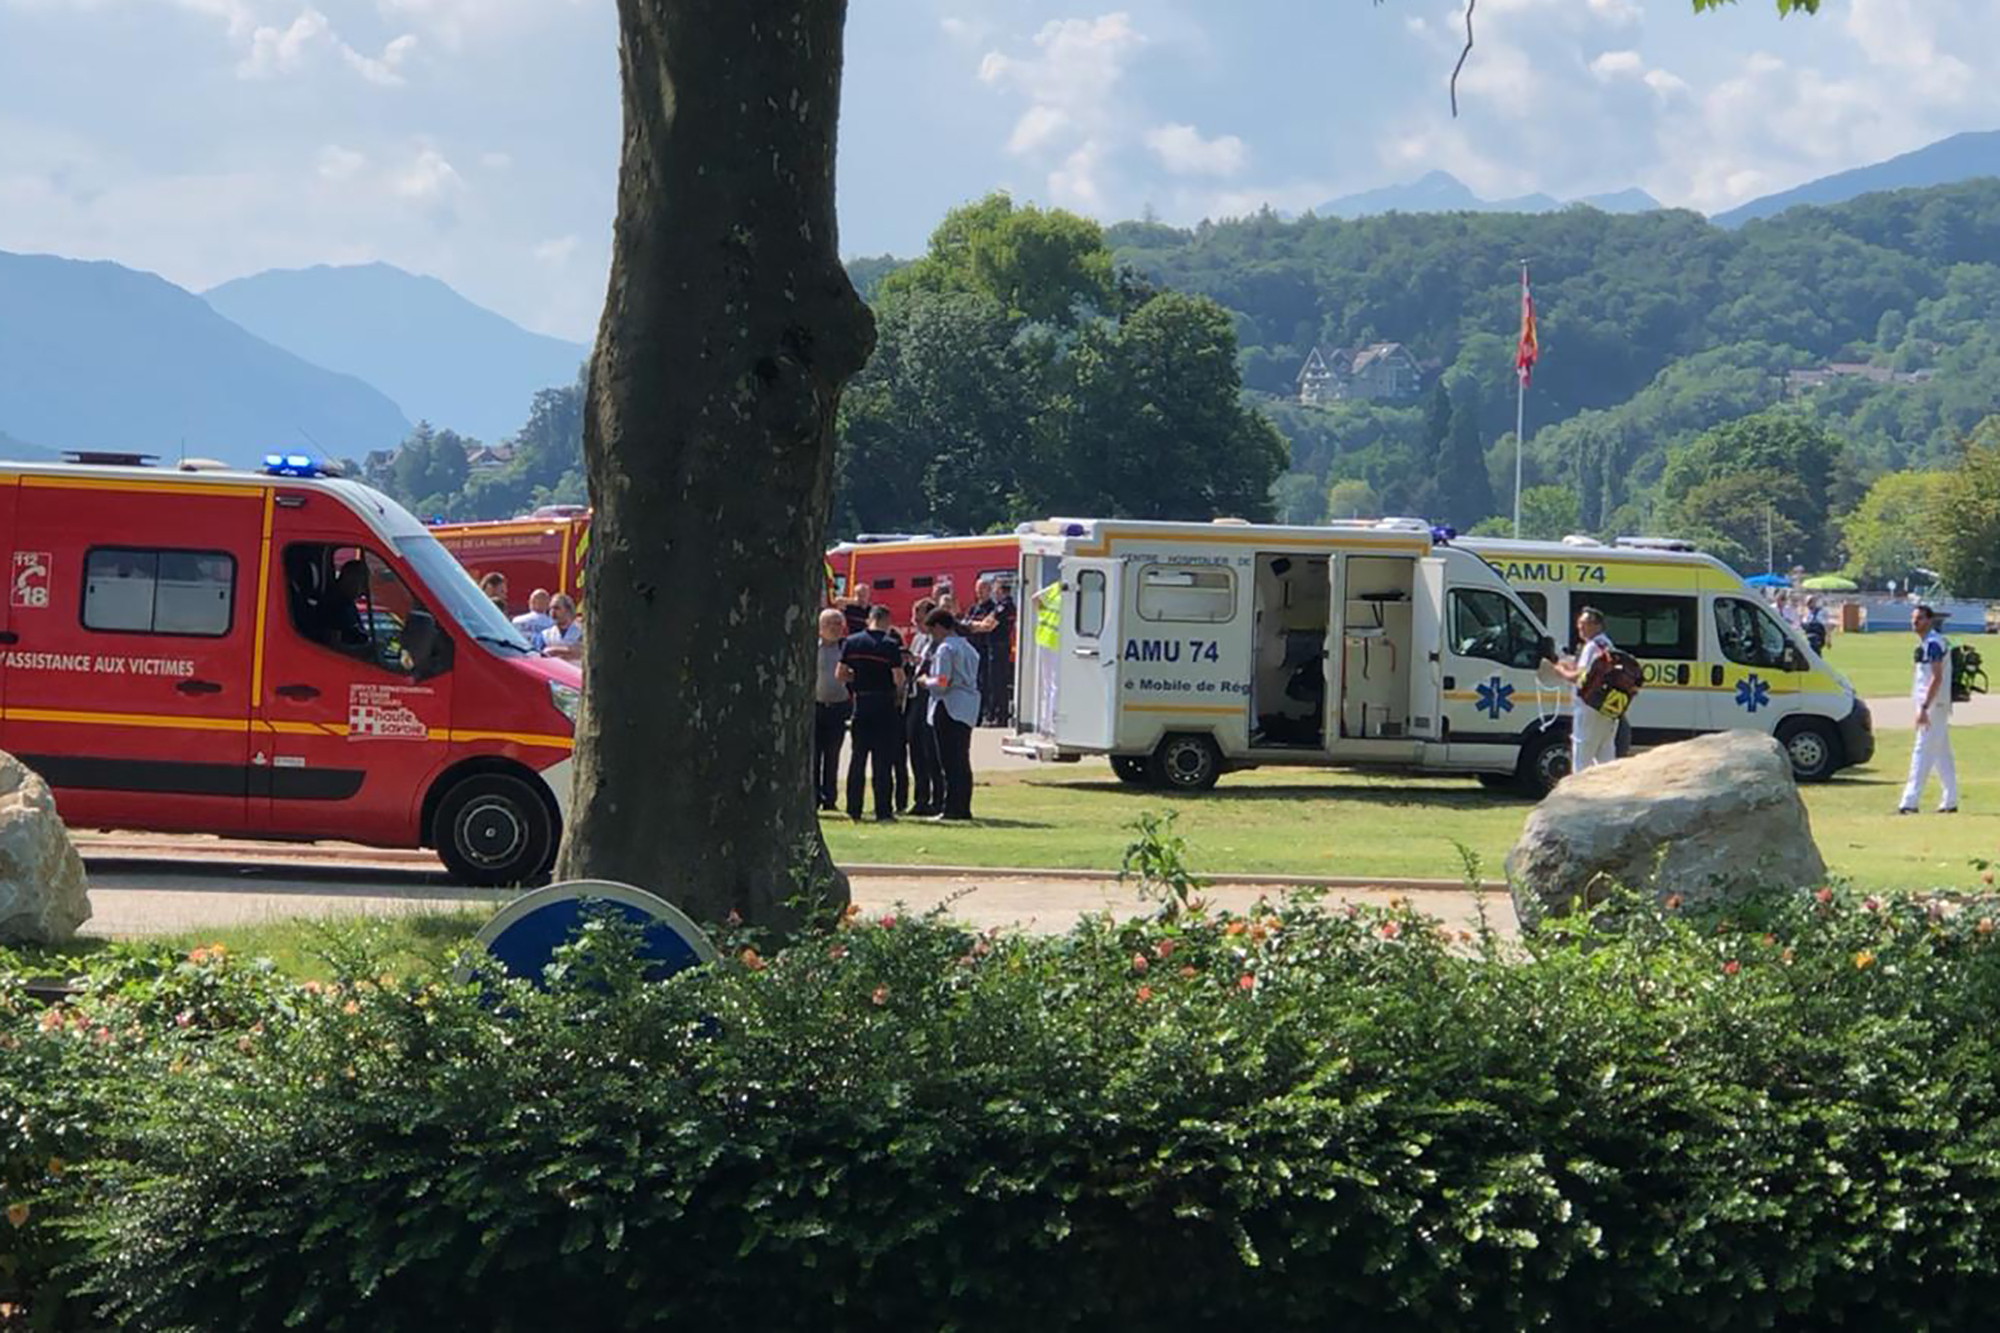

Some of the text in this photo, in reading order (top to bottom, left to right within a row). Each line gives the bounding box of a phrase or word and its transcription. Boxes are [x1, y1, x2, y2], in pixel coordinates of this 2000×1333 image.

[1575, 564, 1606, 583] 74
[19, 587, 47, 605] 18
[1189, 641, 1219, 662] 74
[94, 656, 125, 673] AUX
[128, 658, 195, 676] VICTIMES
[1140, 679, 1191, 691] Mobile
[1196, 681, 1216, 692] de
